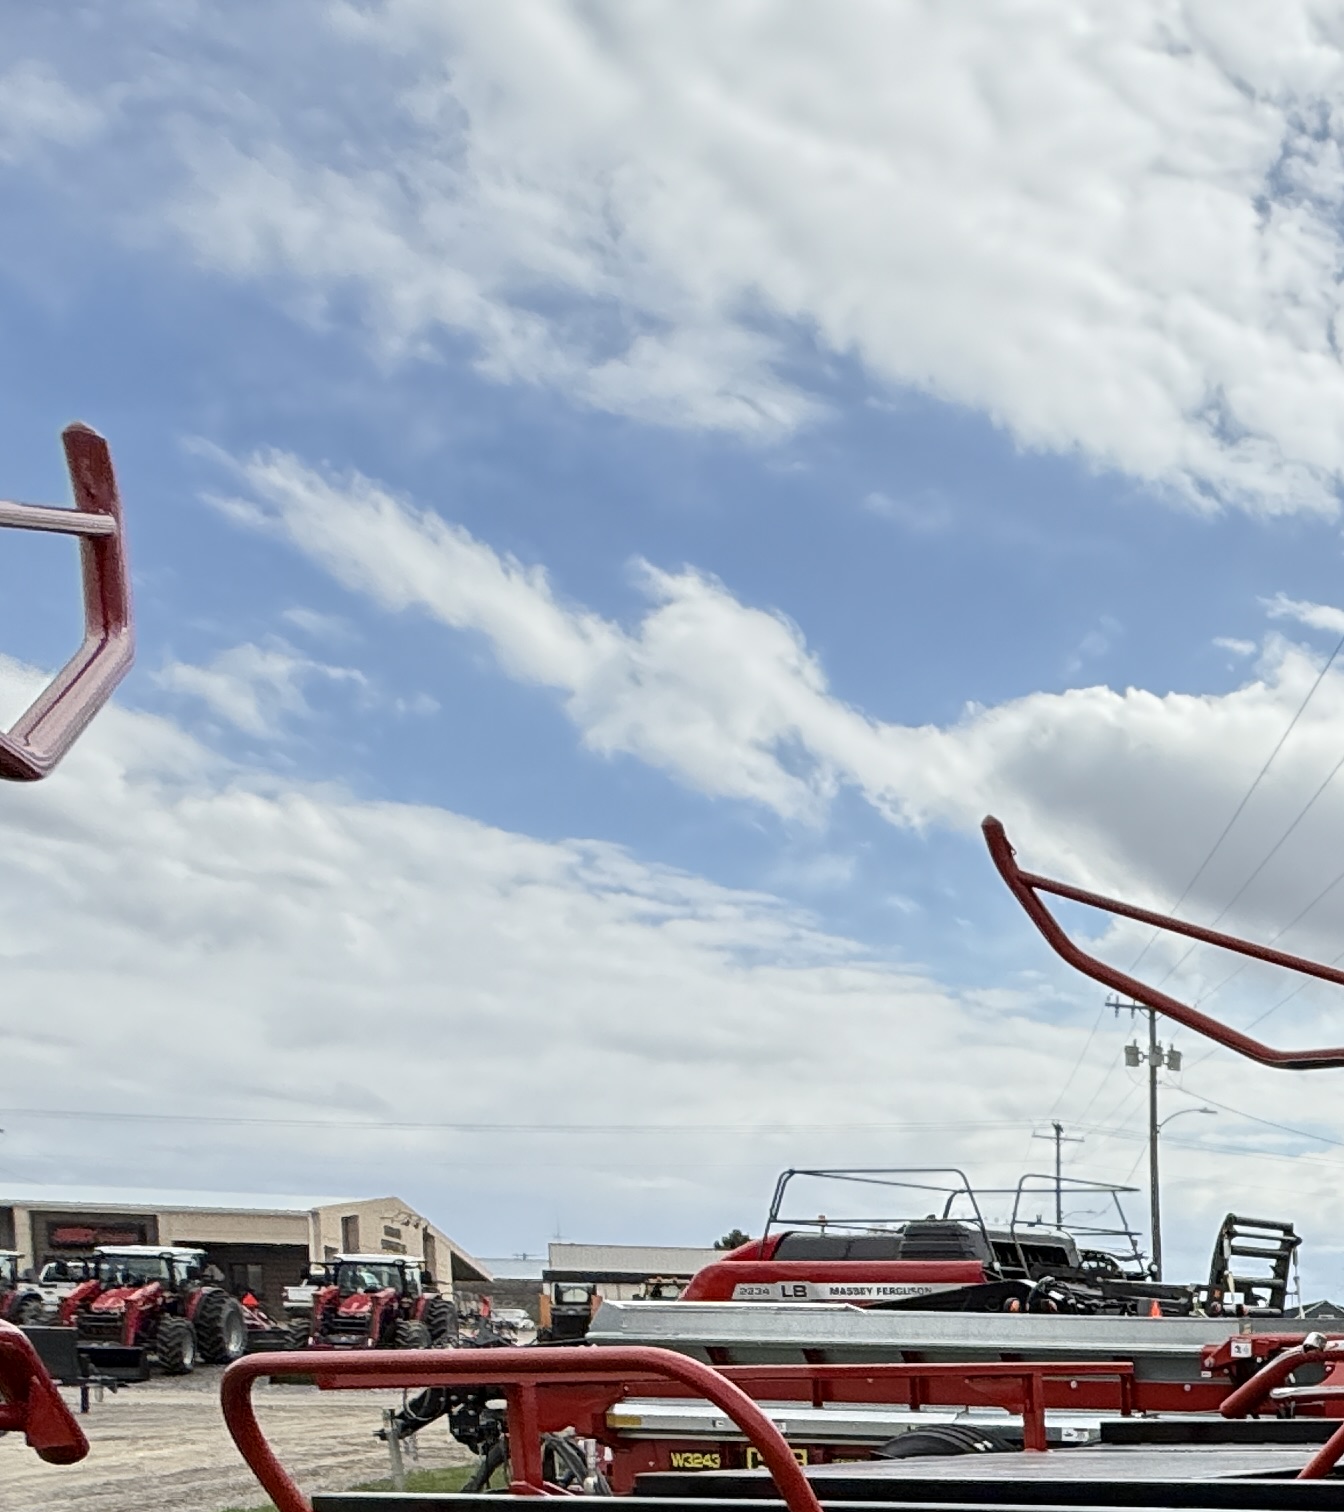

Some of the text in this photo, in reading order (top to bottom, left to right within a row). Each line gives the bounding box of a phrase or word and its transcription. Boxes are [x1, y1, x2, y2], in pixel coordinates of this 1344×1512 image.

[781, 1285, 808, 1298] LB
[829, 1287, 873, 1296] MASSEY
[876, 1287, 933, 1296] FERGUSON
[671, 1451, 721, 1469] W3243
